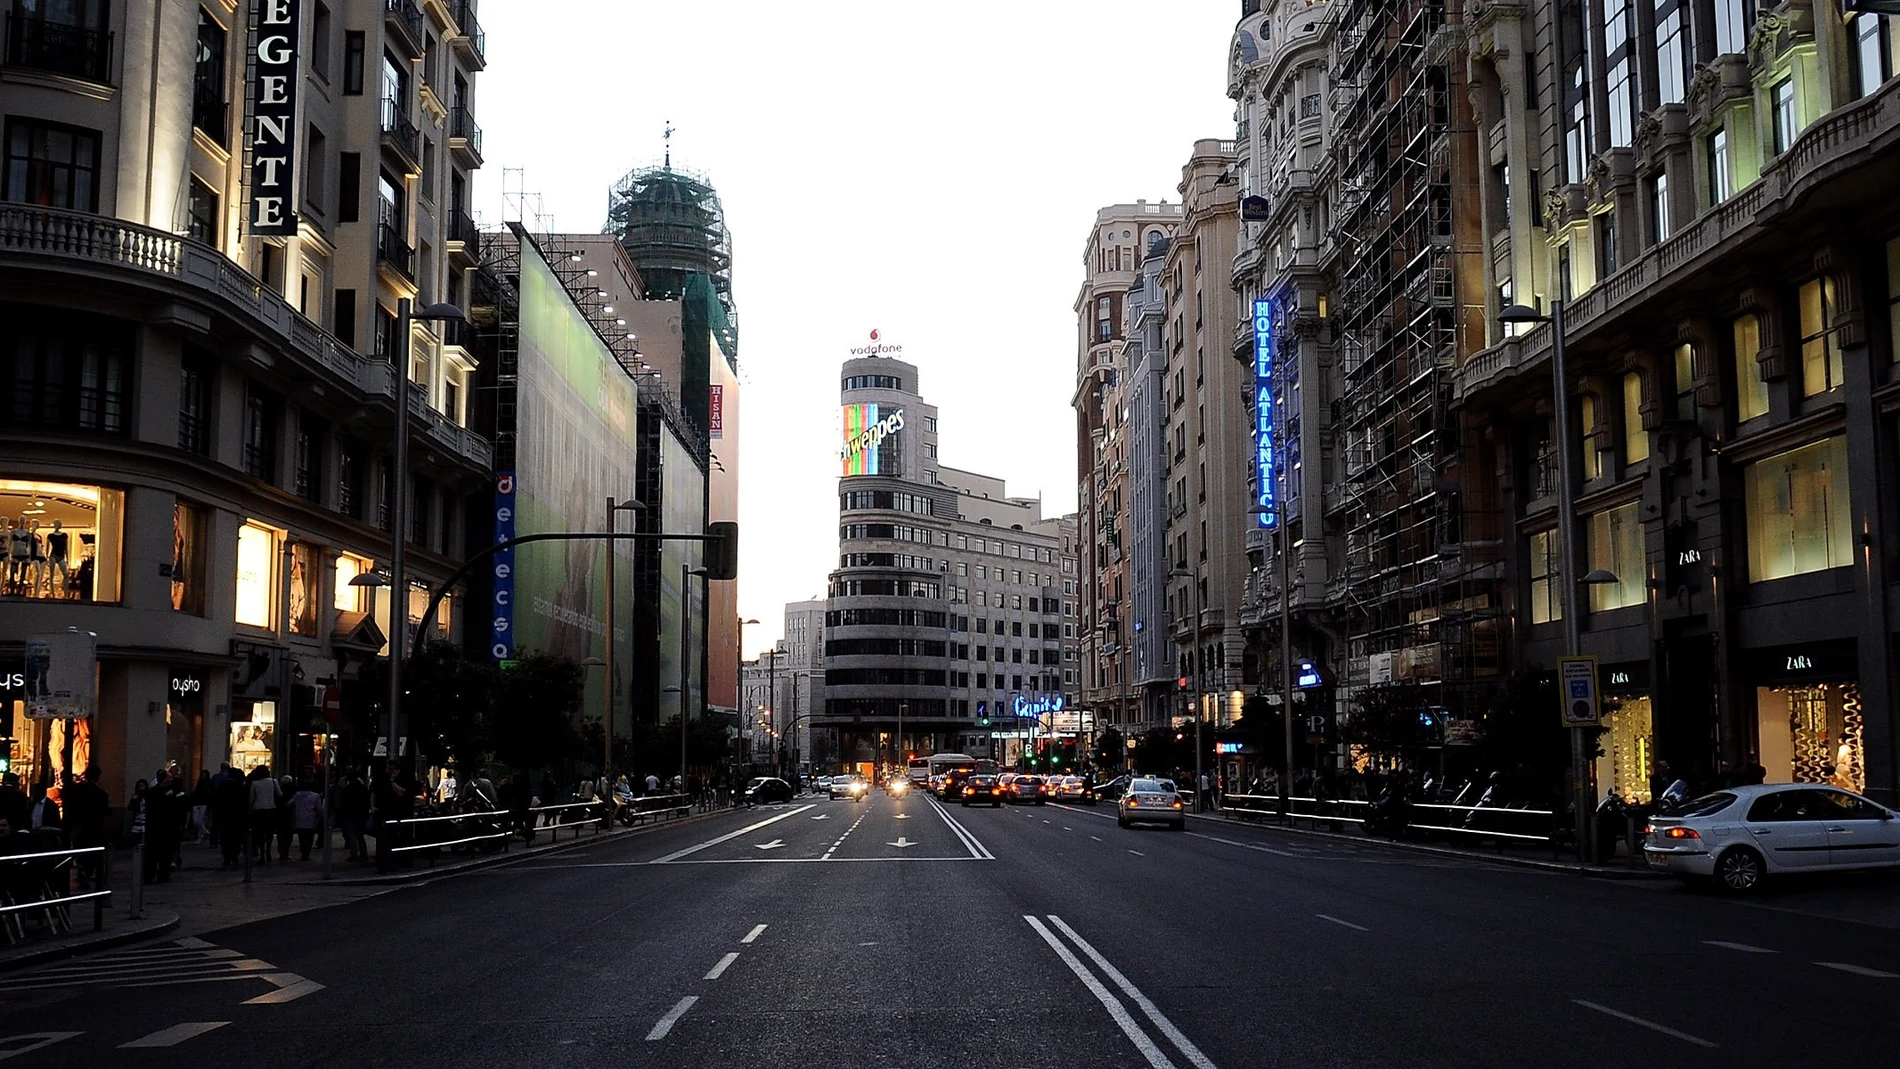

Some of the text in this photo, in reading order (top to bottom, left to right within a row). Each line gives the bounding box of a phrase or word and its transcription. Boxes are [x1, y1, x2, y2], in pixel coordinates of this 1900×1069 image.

[849, 343, 903, 355] vodafone
[711, 386, 721, 429] HISAN
[1255, 301, 1275, 526] HOTEL ATLANTICO
[841, 409, 905, 462] hweppes
[1679, 549, 1701, 566] ZARA
[1786, 655, 1812, 670] ZARA
[172, 674, 200, 697] oysho
[1611, 672, 1629, 684] ZARA
